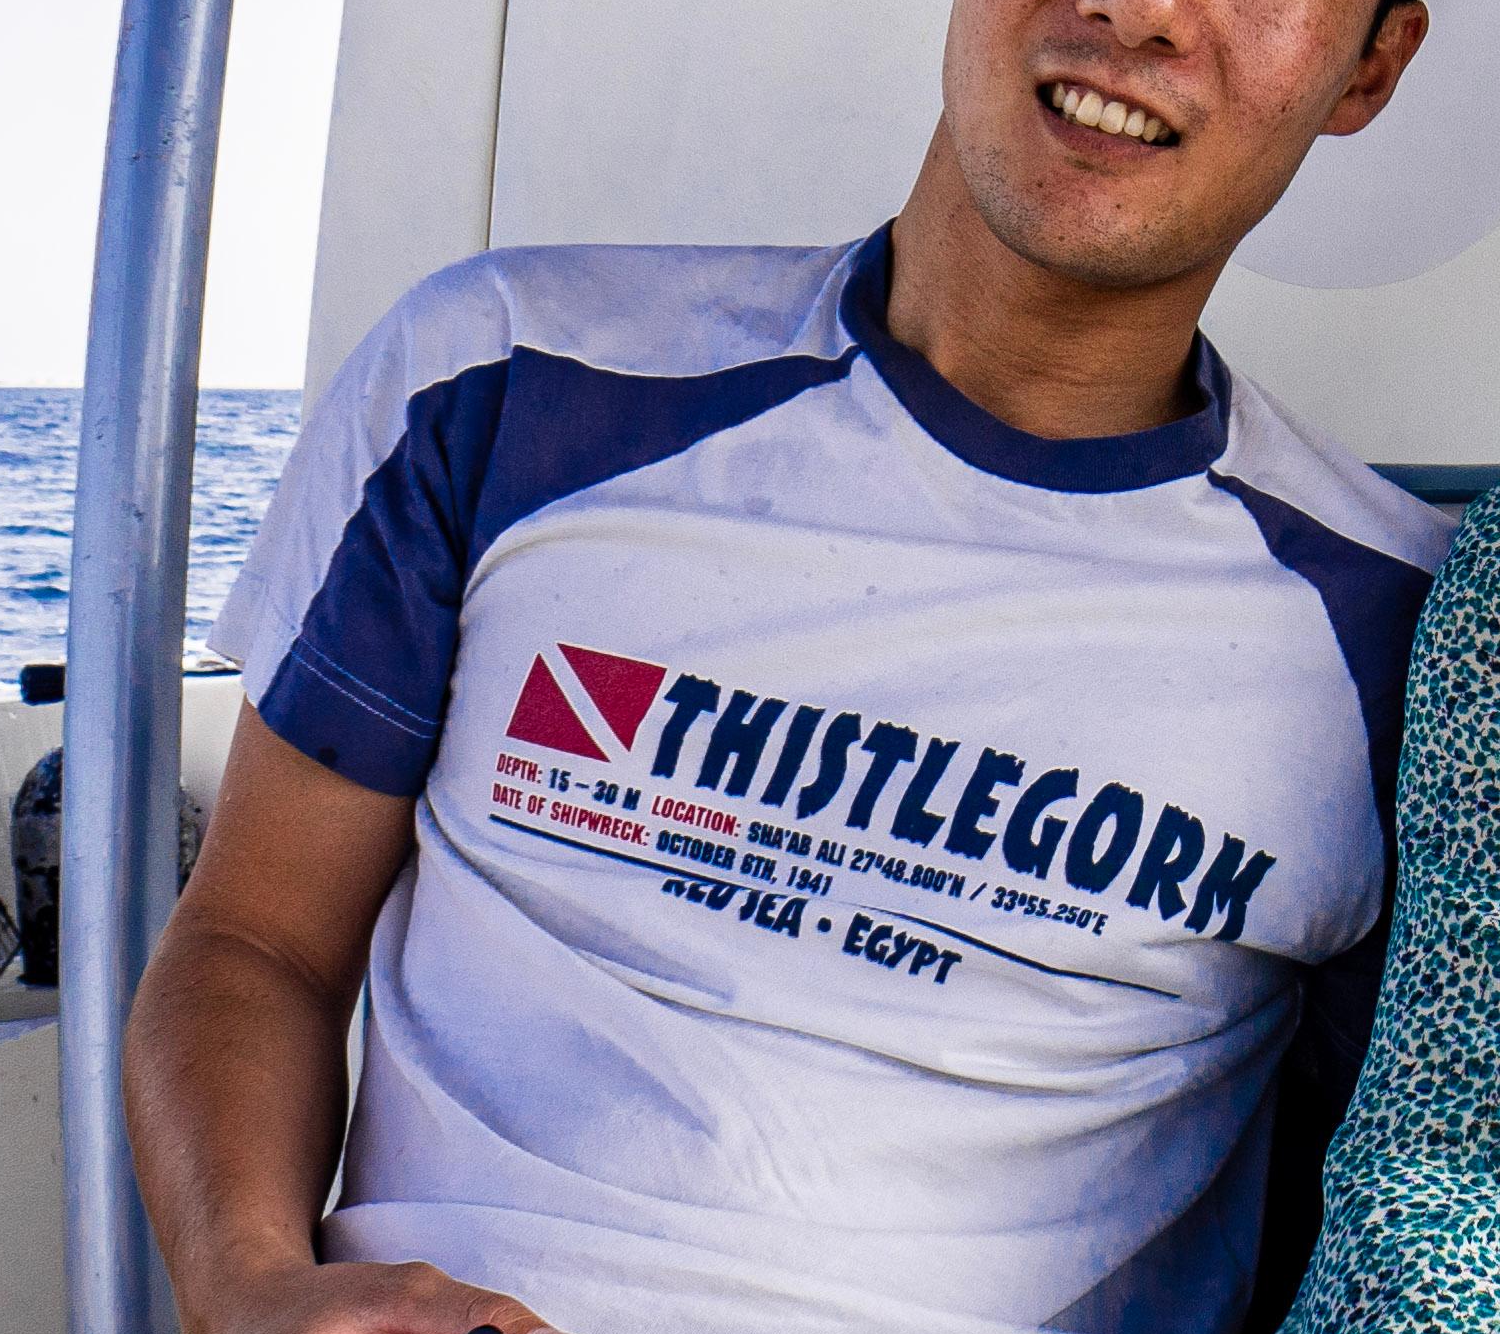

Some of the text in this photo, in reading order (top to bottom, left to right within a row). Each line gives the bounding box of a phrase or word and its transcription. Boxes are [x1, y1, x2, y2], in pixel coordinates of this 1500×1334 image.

[492, 782, 524, 810] DATE
[526, 794, 547, 816] OF
[550, 801, 651, 846] SHIPWRECK:
[656, 829, 736, 871] OCTOBER
[787, 865, 833, 897] 1941
[496, 753, 543, 784] DEPTH:
[549, 767, 571, 793] 15
[592, 779, 619, 805] 30
[651, 795, 742, 838] LOCATION:
[815, 839, 847, 866] ALI
[650, 672, 1278, 941] THISTLEGORM
[842, 912, 963, 985] EGYPT
